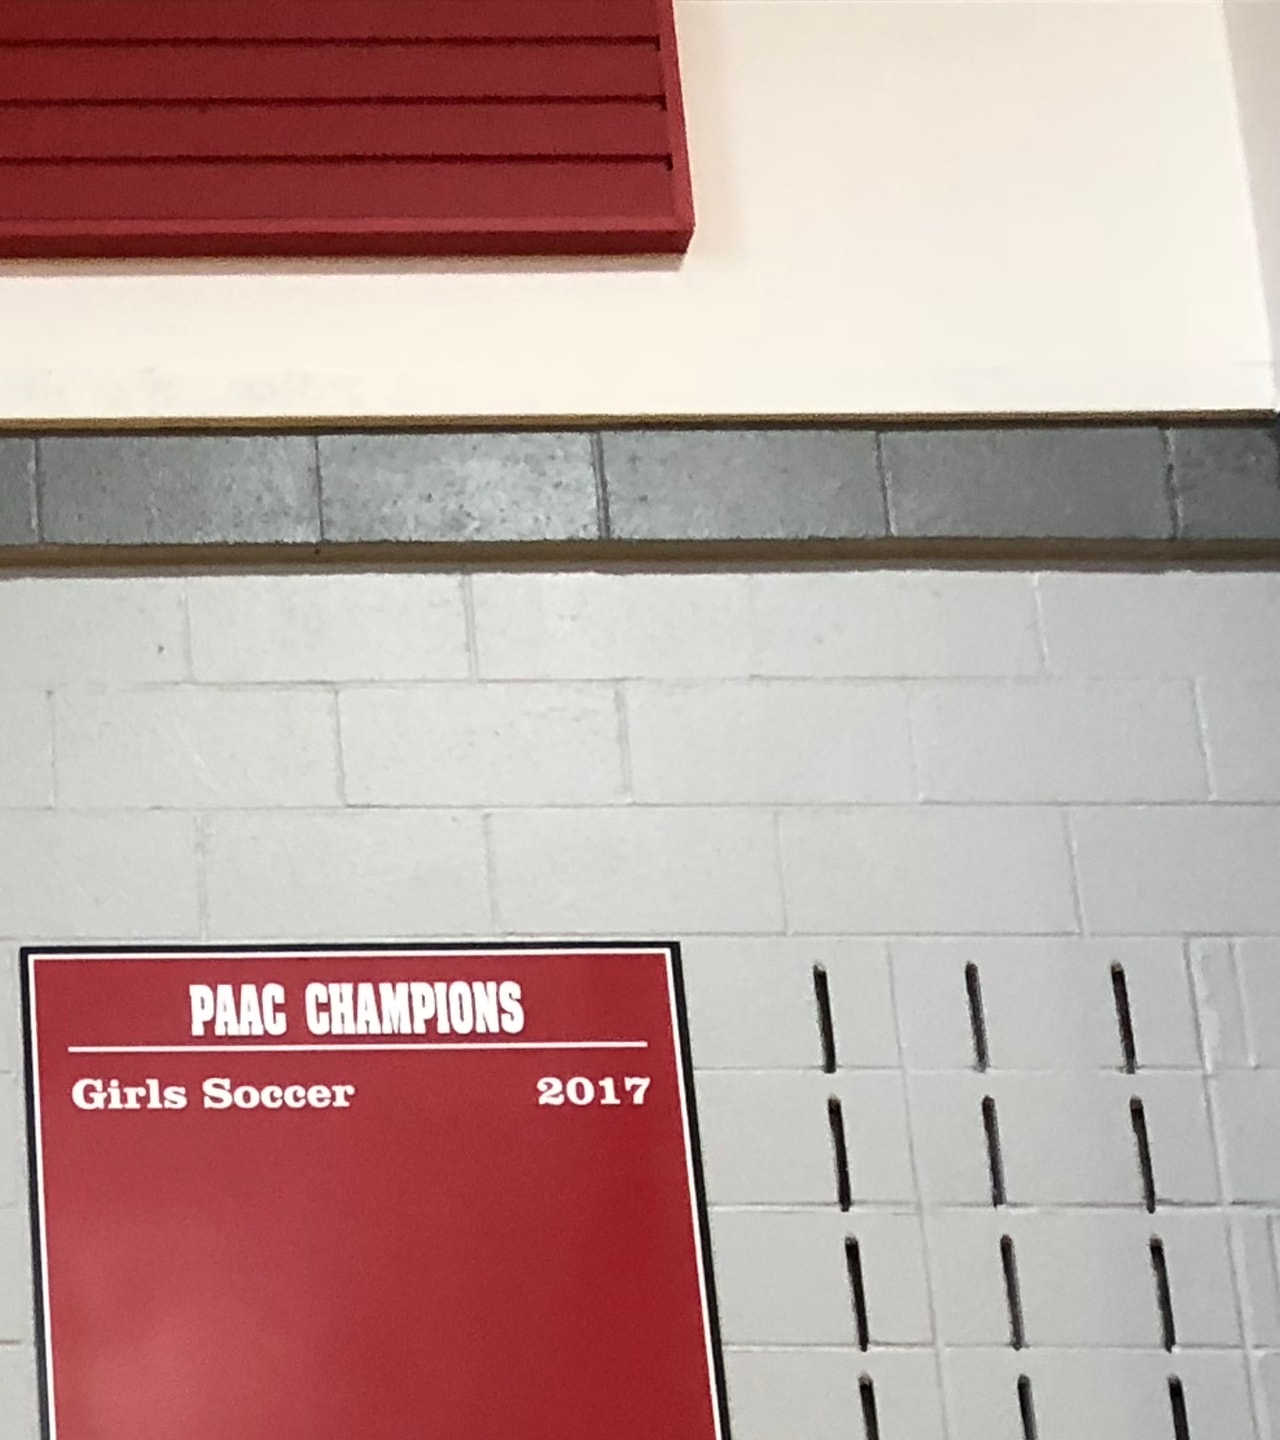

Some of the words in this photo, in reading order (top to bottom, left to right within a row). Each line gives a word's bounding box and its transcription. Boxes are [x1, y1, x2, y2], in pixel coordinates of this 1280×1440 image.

[190, 984, 286, 1036] PAAC
[305, 982, 523, 1034] CHAMPIONS
[71, 1078, 187, 1109] Girls
[203, 1078, 355, 1109] Soccer
[536, 1077, 651, 1105] 2017
